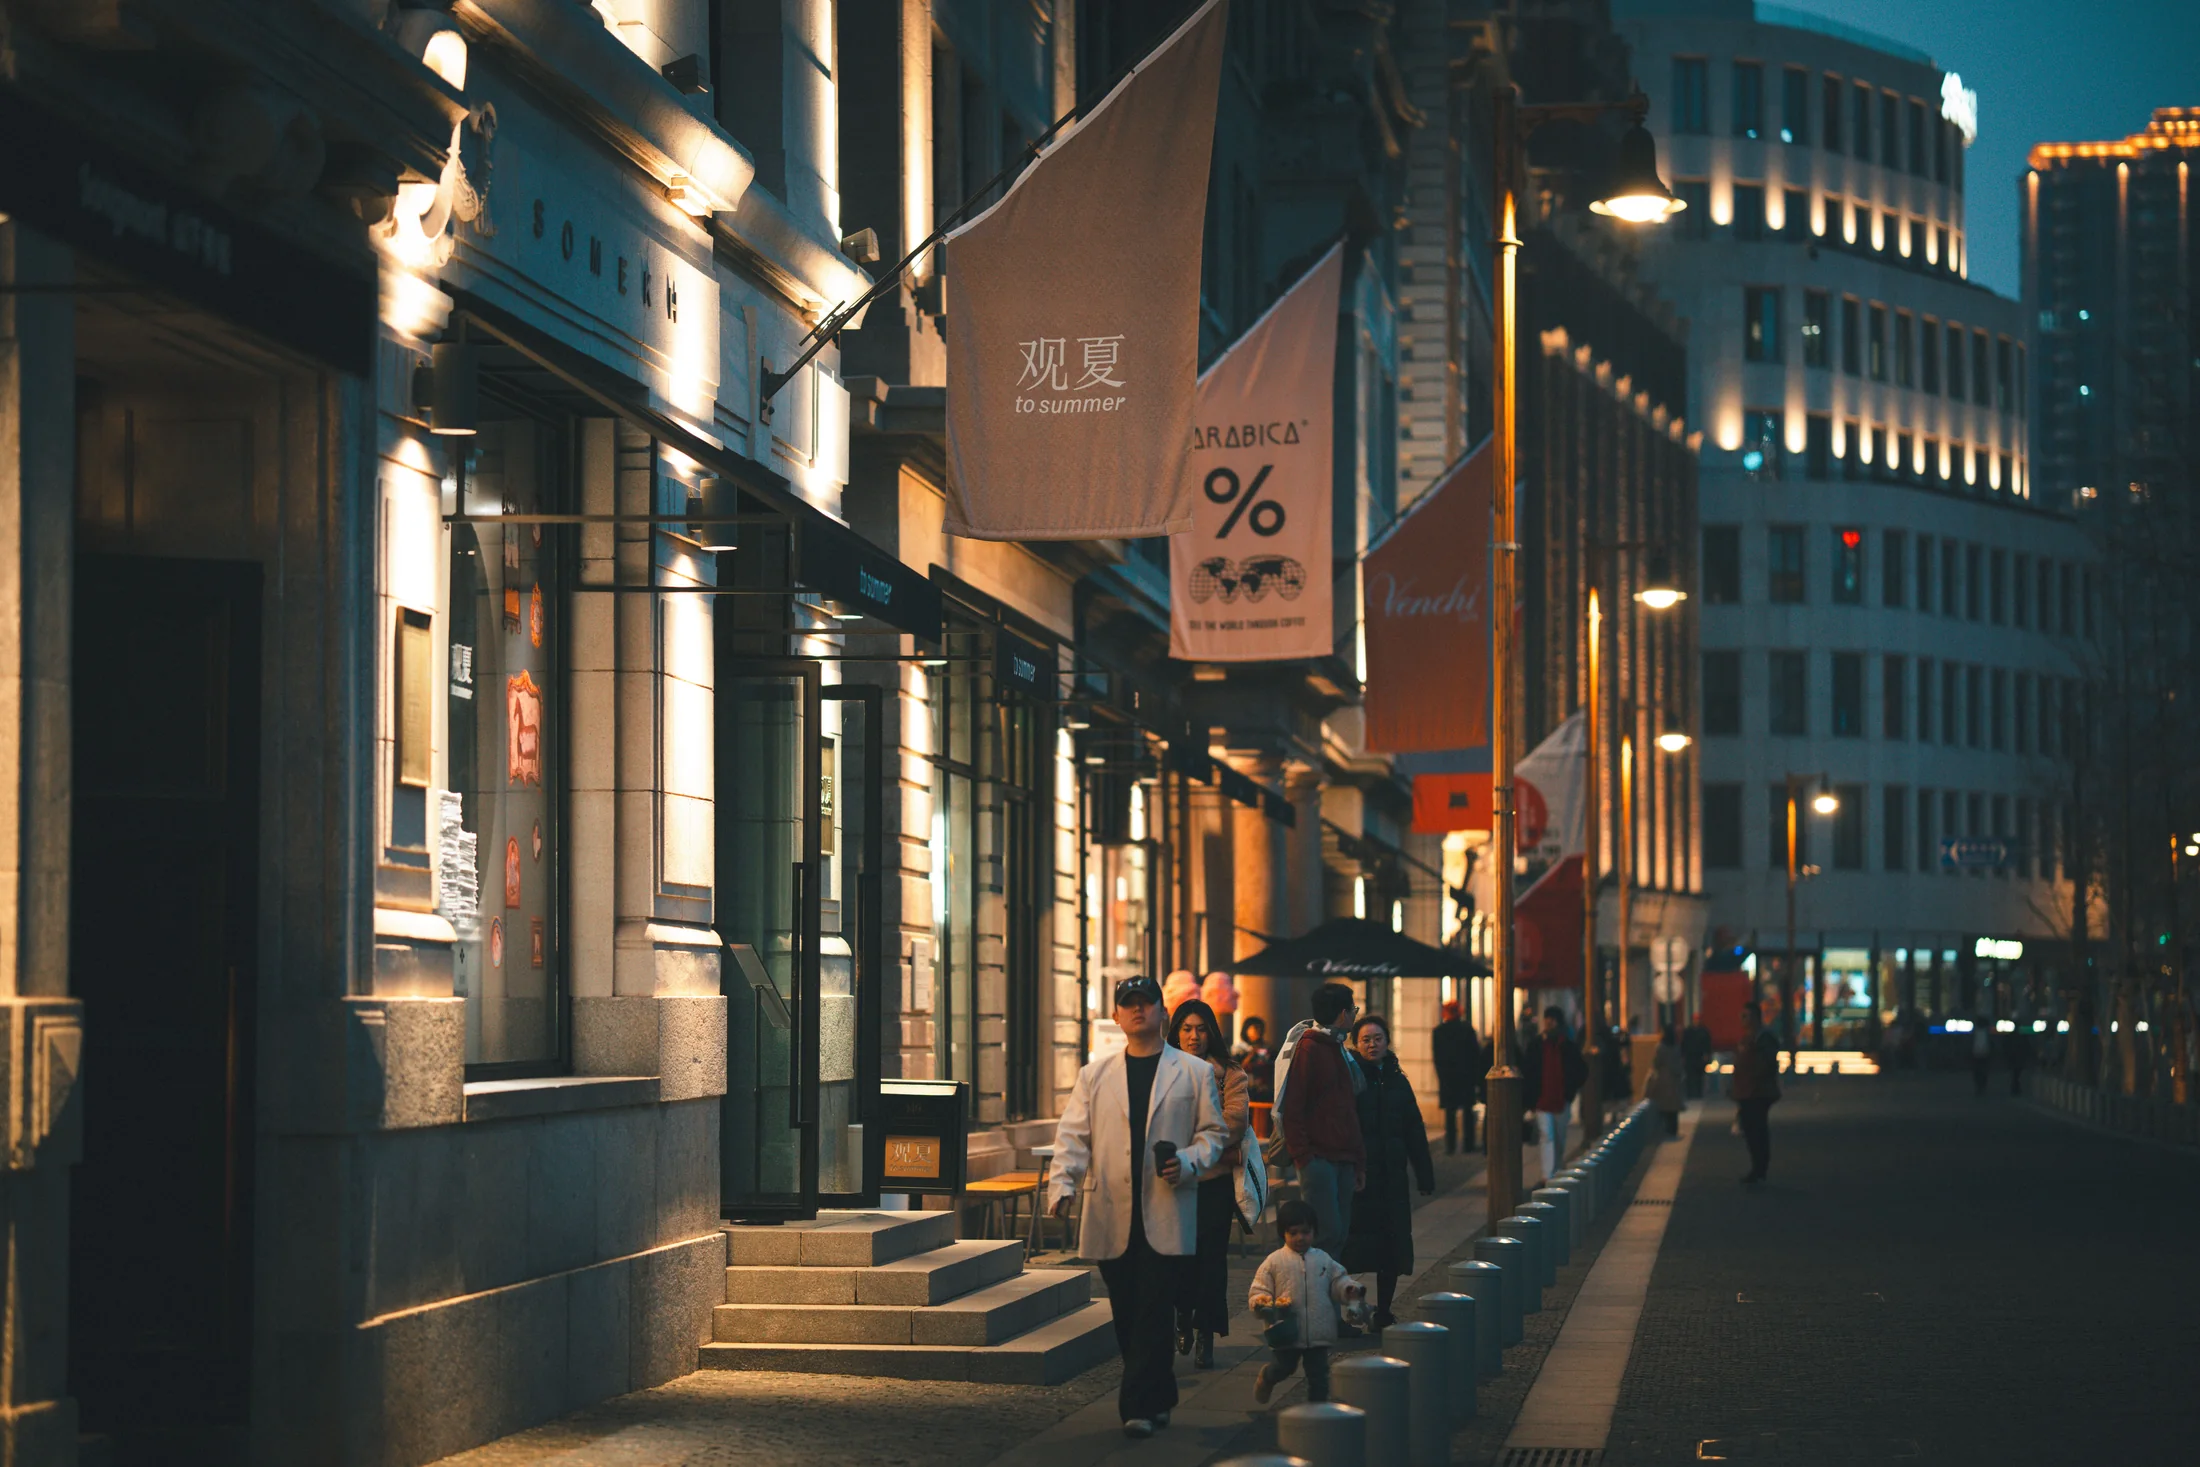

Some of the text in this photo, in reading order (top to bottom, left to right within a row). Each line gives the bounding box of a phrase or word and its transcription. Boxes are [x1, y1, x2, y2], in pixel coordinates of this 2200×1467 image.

[533, 199, 677, 323] SOMEKH
[1016, 333, 1126, 391] 观夏
[1015, 395, 1126, 414] to summer
[1367, 571, 1480, 616] Venchi
[890, 1141, 932, 1163] 观夏
